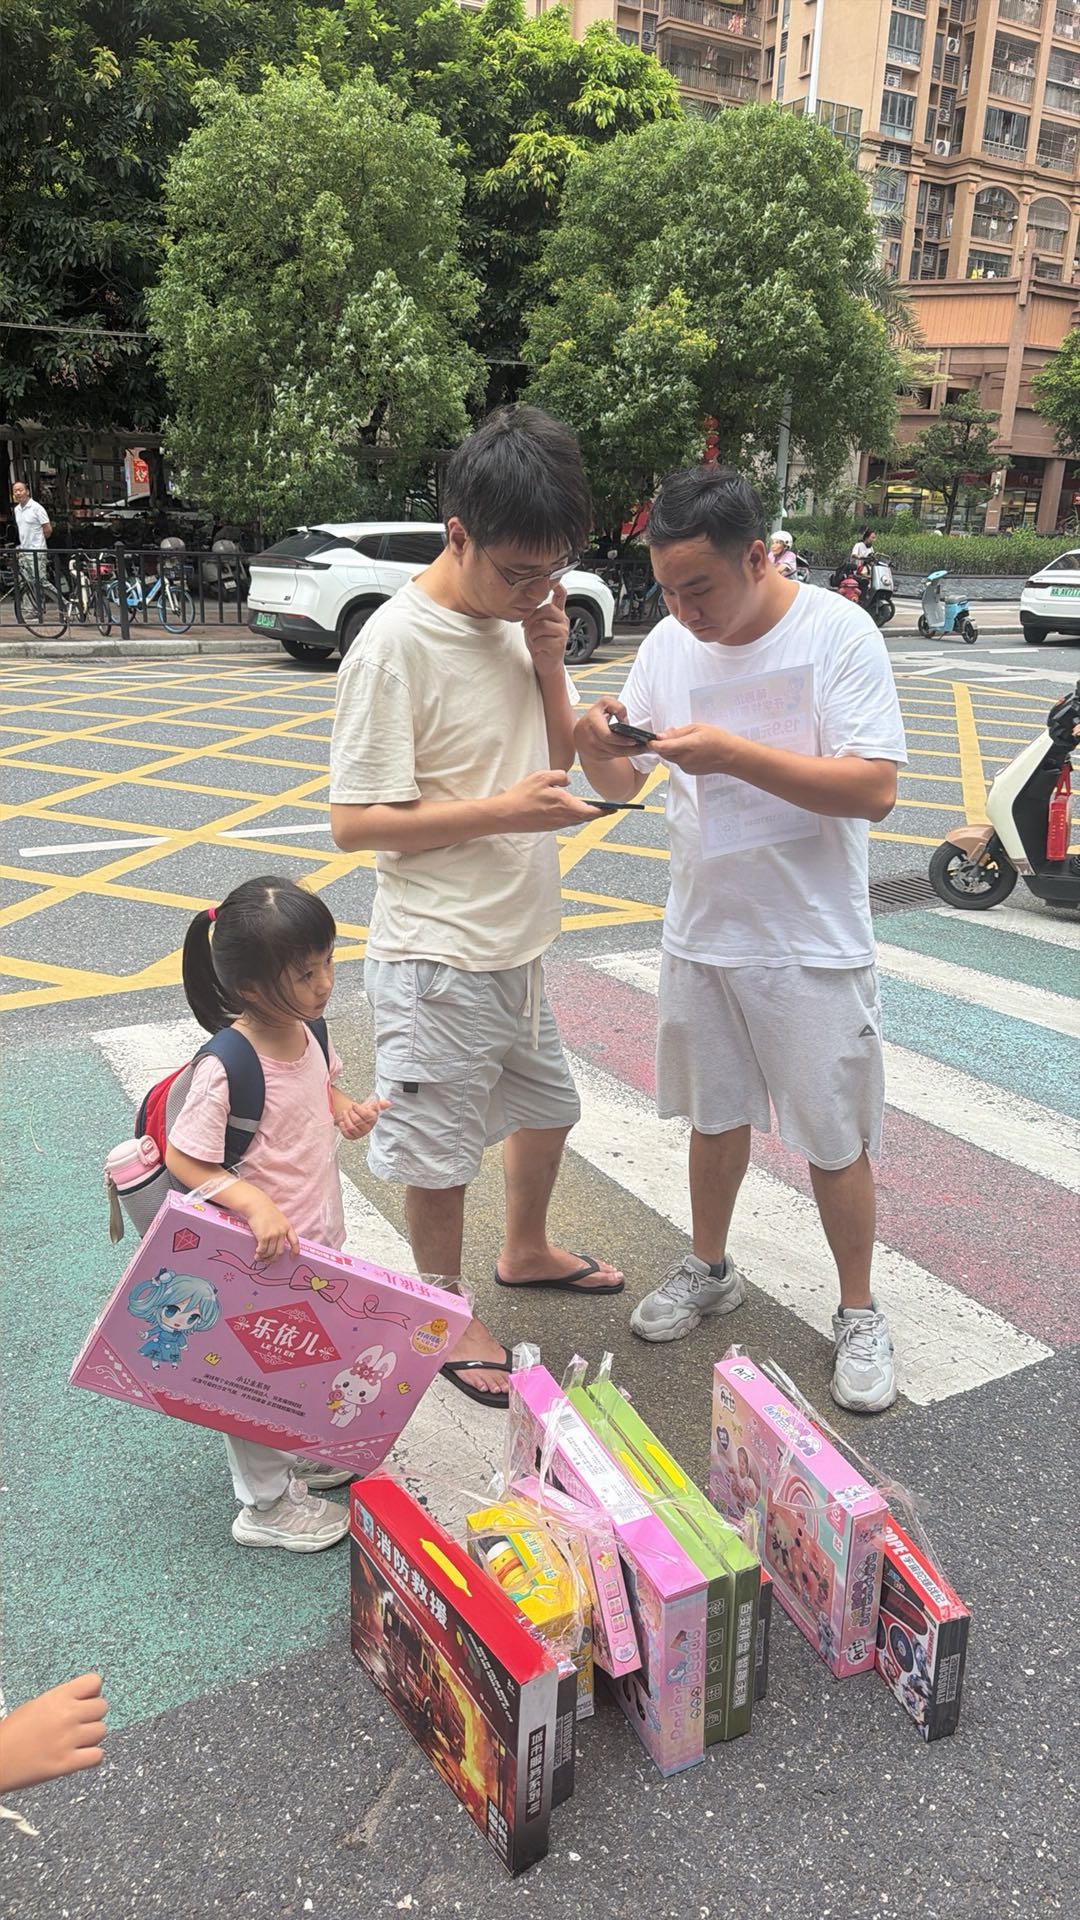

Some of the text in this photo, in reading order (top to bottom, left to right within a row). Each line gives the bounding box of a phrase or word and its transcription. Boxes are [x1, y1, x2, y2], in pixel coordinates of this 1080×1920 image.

[249, 1316, 320, 1356] 乐依儿
[260, 1342, 296, 1359] LE YI ER
[733, 1367, 752, 1381] Art
[720, 1389, 734, 1408] Art
[376, 1526, 448, 1631] 消防救援
[736, 1600, 754, 1657] 百变棋盘
[682, 1629, 703, 1687] Beads
[853, 1642, 864, 1662] Art
[936, 1656, 951, 1705] GYROSCOPE
